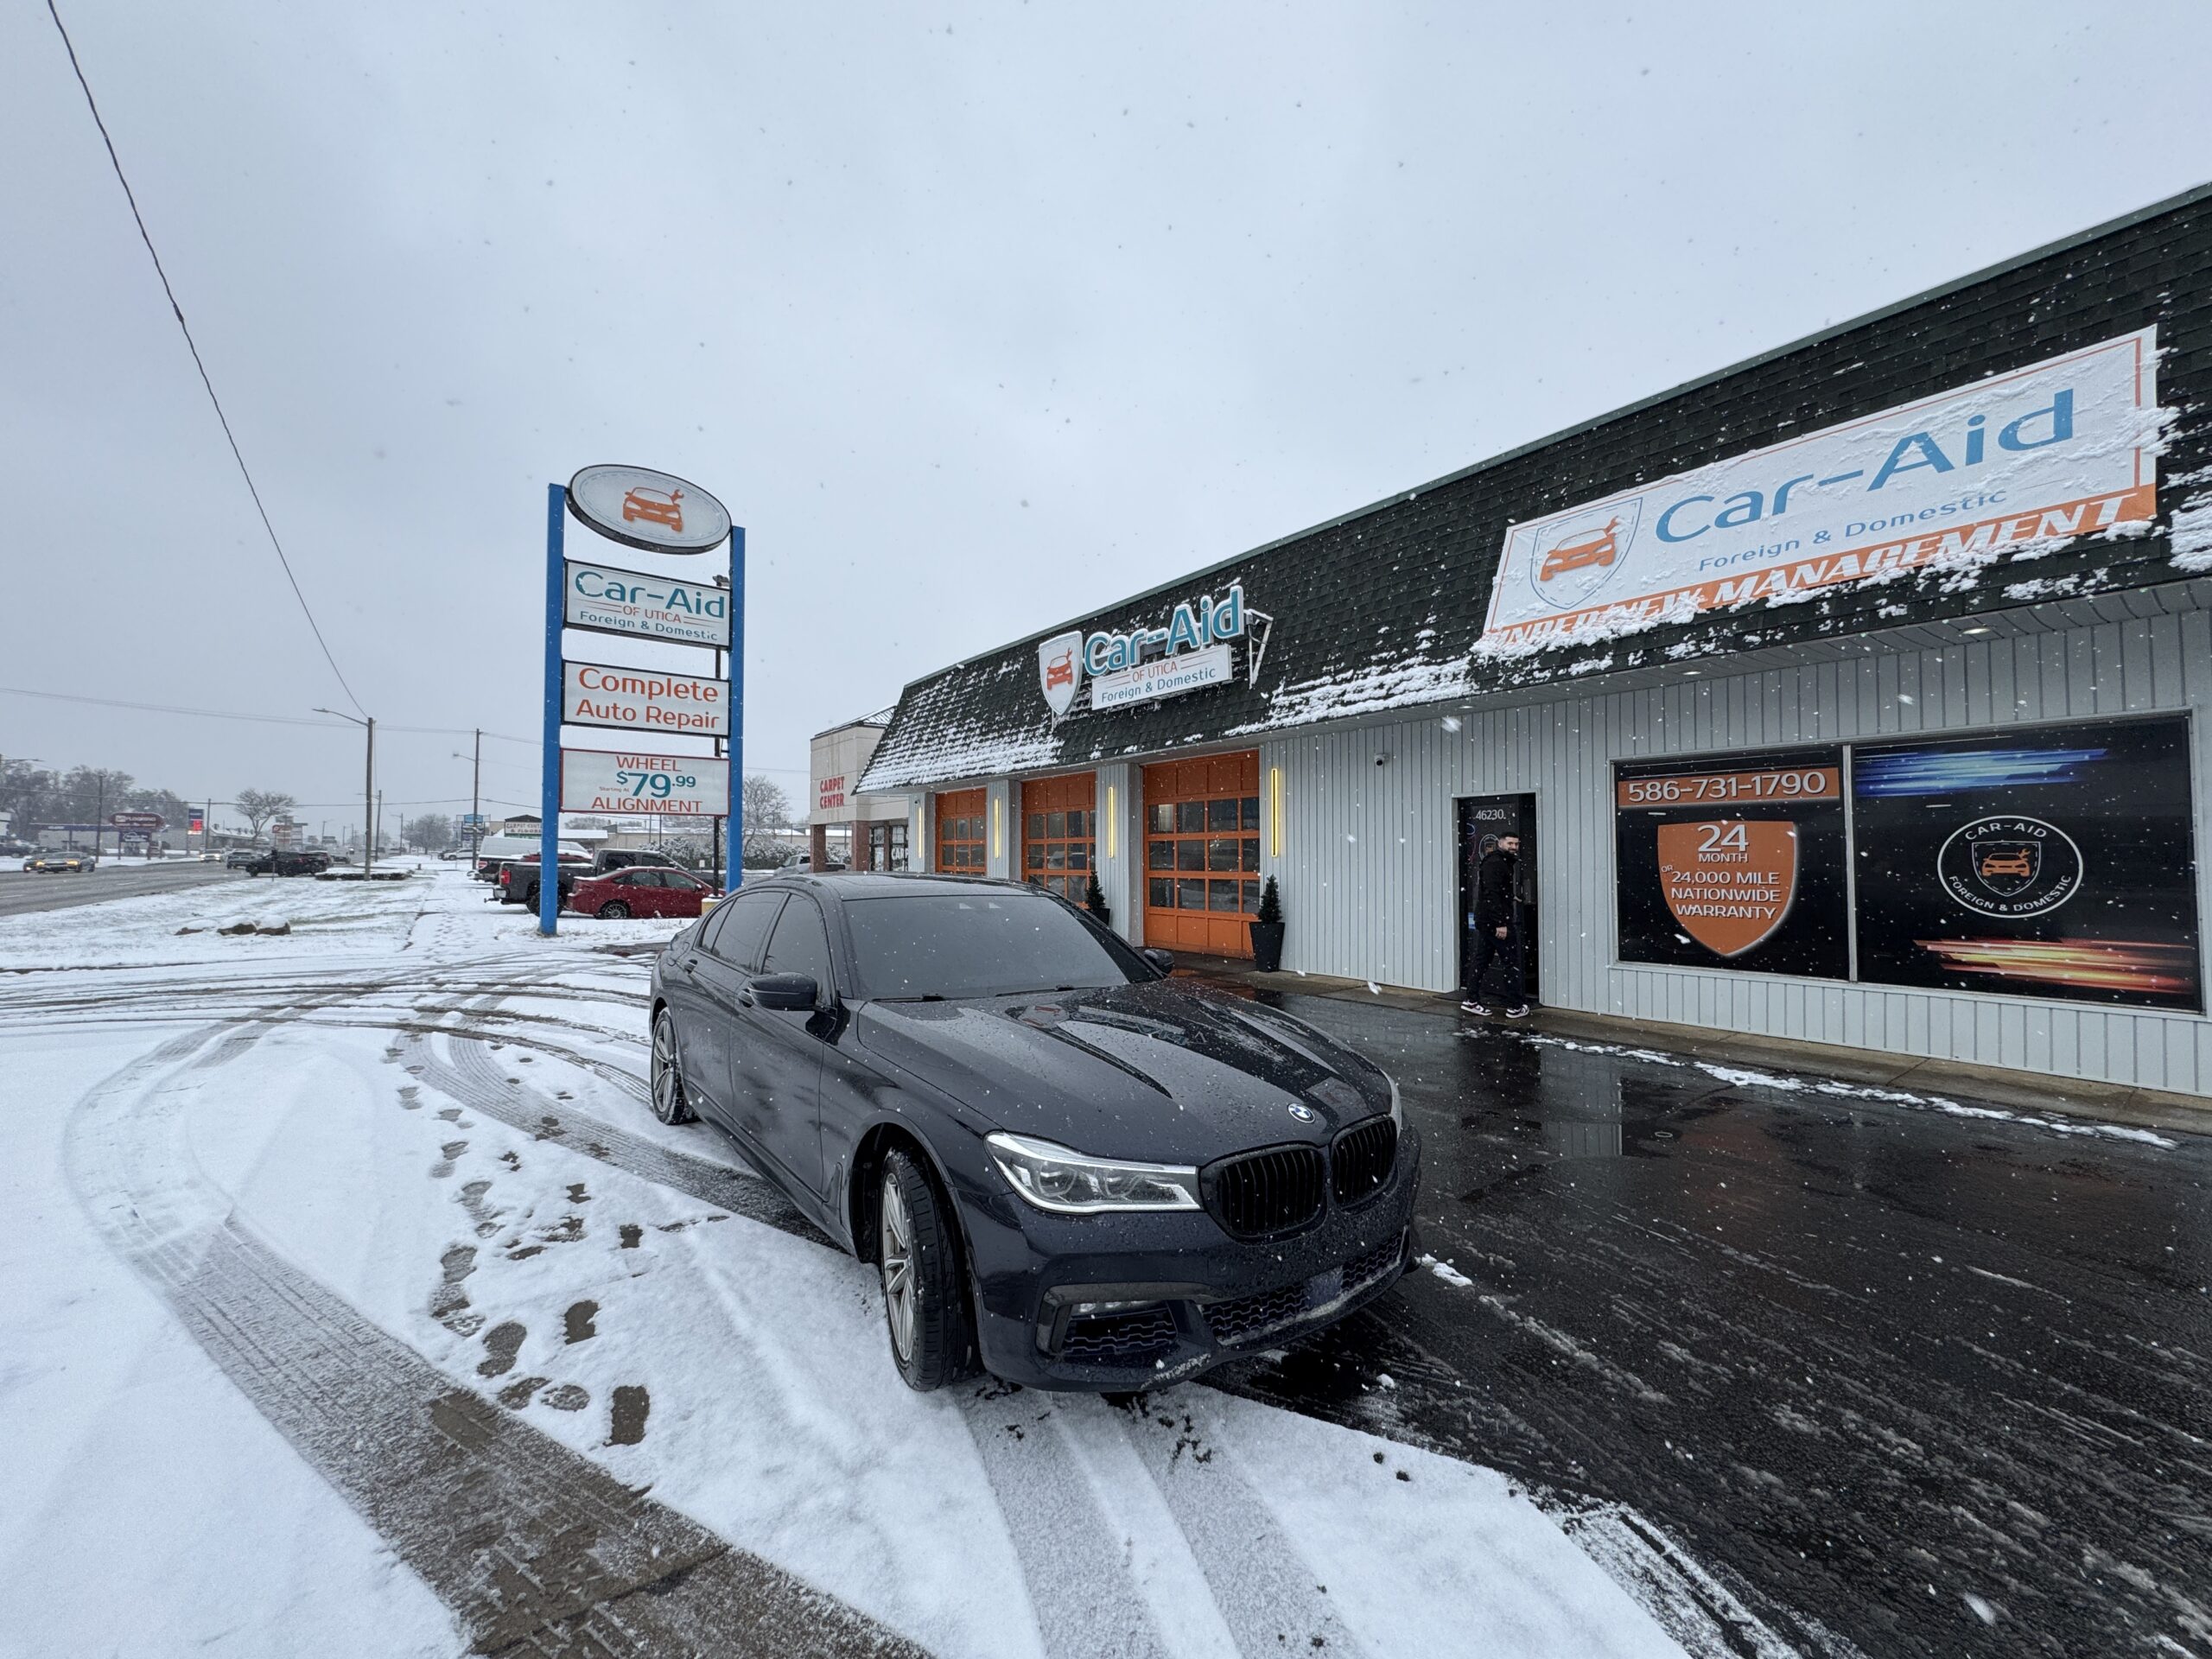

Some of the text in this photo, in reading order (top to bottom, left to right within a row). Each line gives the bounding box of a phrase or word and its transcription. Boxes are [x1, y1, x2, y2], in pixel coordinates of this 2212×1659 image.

[1655, 388, 2074, 543] Car-Aid
[1699, 491, 2008, 573] Foreign & Domestic
[1713, 493, 2139, 605] MANAGEMENT
[575, 570, 725, 619] Car-Aid
[580, 611, 718, 640] Foreign & Domestic
[623, 605, 682, 624] OF UTICA
[1084, 588, 1243, 677] Car-Aid
[579, 667, 718, 702] Complete
[1102, 667, 1217, 702] Foreign & Domestic
[1132, 661, 1178, 683] OF UTICA
[575, 699, 720, 729] Auto Repair
[616, 755, 682, 772] WHEEL
[616, 770, 696, 798] $79.99
[820, 776, 845, 793] CARPET
[1628, 772, 1827, 803] 586-731-1790
[591, 797, 702, 813] ALIGNMENT
[820, 793, 844, 810] CENTER
[1476, 809, 1504, 820] 46230
[1698, 823, 1750, 853] 24
[1965, 822, 2047, 841] CAR-AID
[1661, 864, 1674, 873] OR
[1698, 852, 1749, 863] MONTH
[1672, 870, 1780, 886] 24,000 MILE
[1671, 887, 1782, 902] NATIONWIDE
[1949, 875, 1994, 910] FOREIGN
[2013, 874, 2072, 912] DOMESTIC
[1675, 904, 1777, 920] WARRANTY
